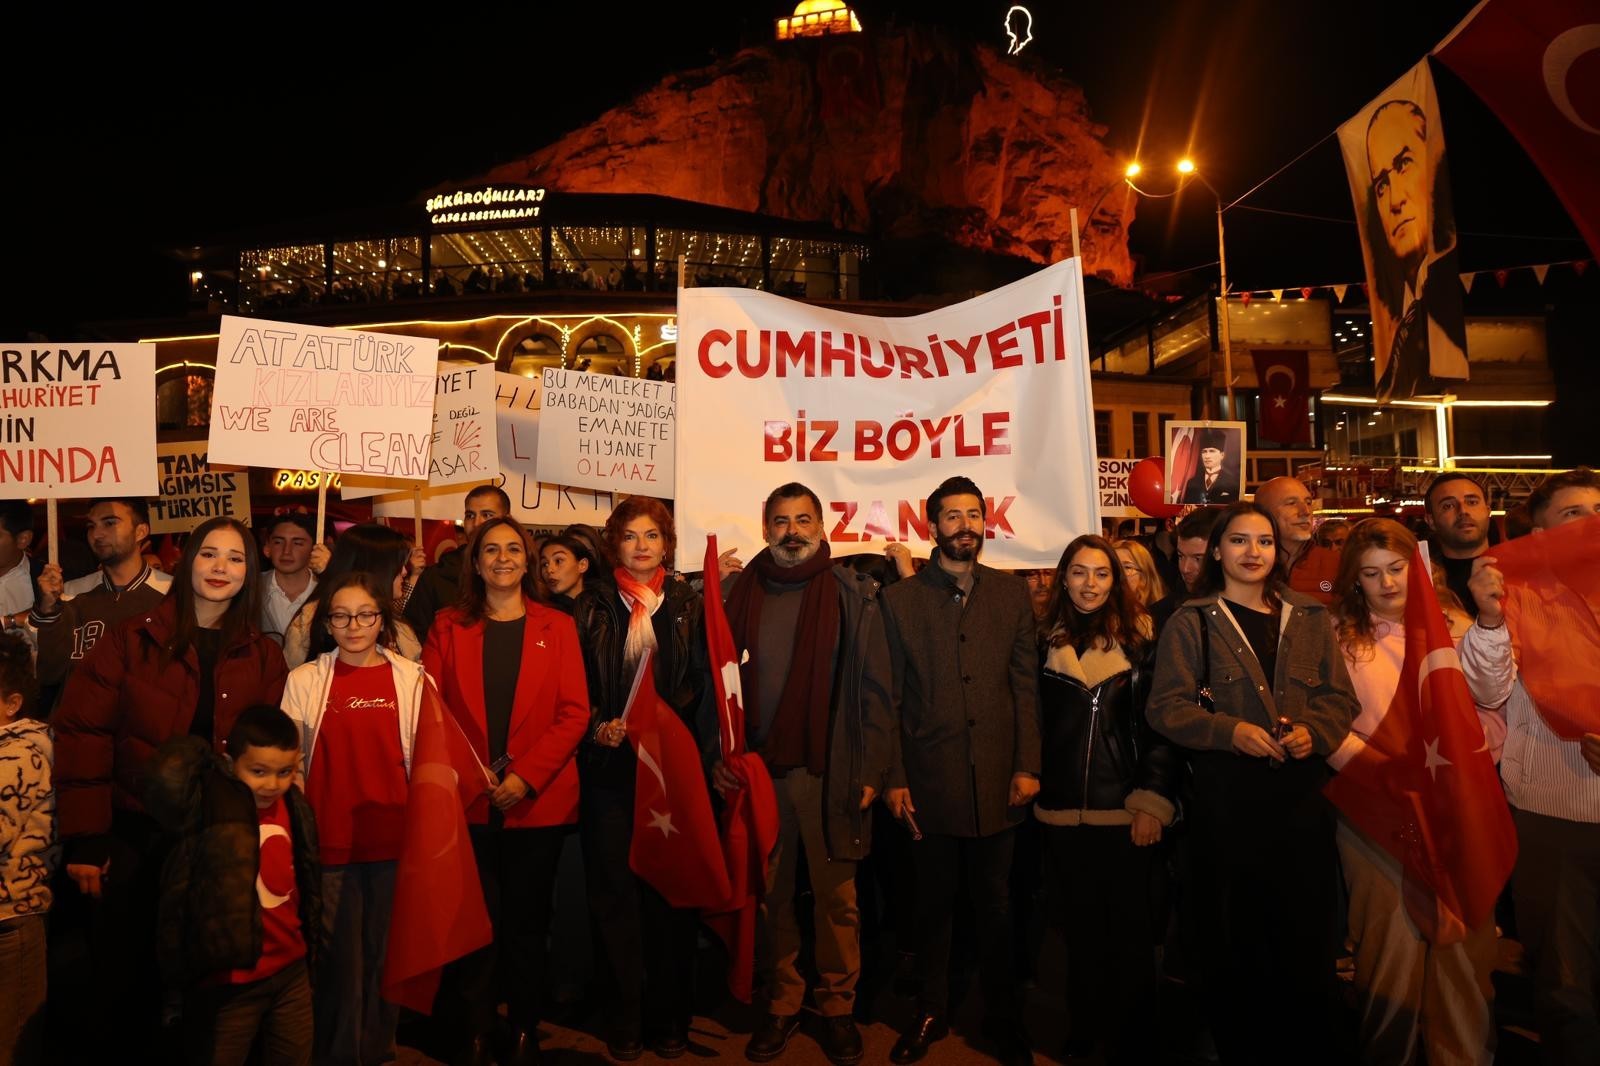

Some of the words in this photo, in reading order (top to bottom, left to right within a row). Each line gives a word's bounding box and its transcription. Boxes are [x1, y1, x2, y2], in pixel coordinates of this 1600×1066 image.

[697, 294, 1067, 380] CUMHURİYETİ
[231, 328, 415, 374] ATATÜRK
[0, 384, 101, 409] HURİYET
[251, 368, 435, 408] KIZLARIYIZ
[543, 369, 567, 389] BU
[576, 375, 662, 400] MEMLEKET
[547, 392, 620, 415] BABADAN
[220, 405, 272, 432] WE
[290, 407, 340, 432] ARE
[578, 416, 669, 441] EMANETE
[764, 410, 838, 462] BİZ
[854, 410, 1012, 461] BÖYLE
[310, 432, 432, 476] CLEAN
[579, 439, 656, 461] HIYANET
[157, 453, 210, 474] TAM
[577, 458, 657, 482] OLMAZ
[150, 495, 234, 520] TÜRKİYE
